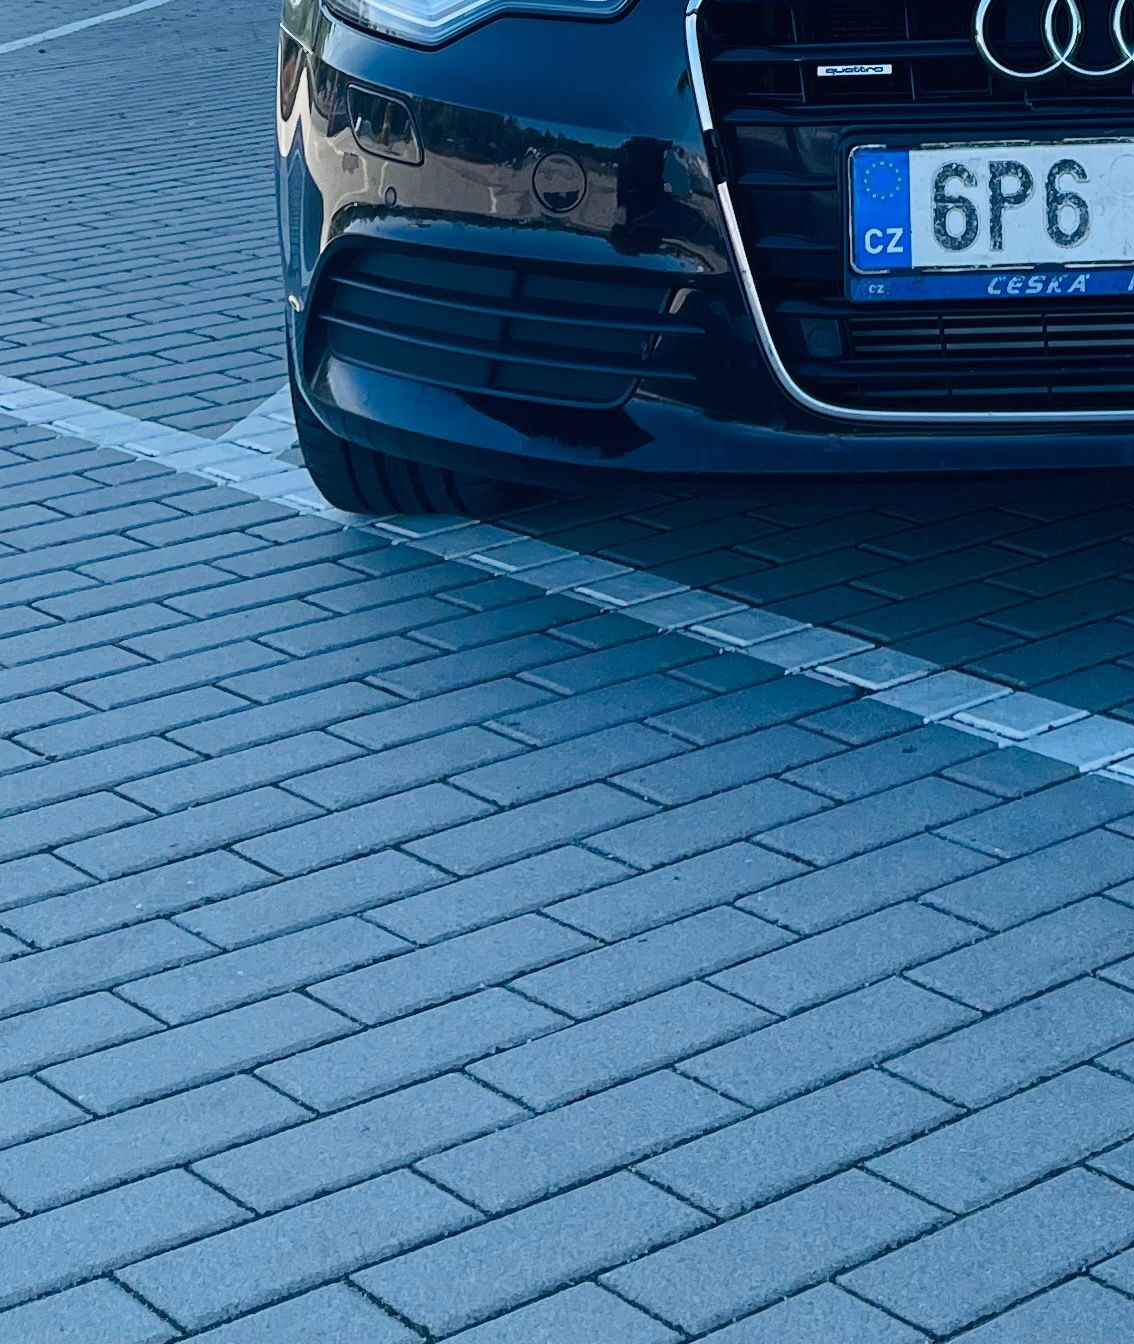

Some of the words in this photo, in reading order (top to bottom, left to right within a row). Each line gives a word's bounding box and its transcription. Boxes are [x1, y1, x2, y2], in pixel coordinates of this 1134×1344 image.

[825, 66, 884, 76] quattro
[932, 158, 1091, 252] 6P6
[864, 227, 904, 255] CZ
